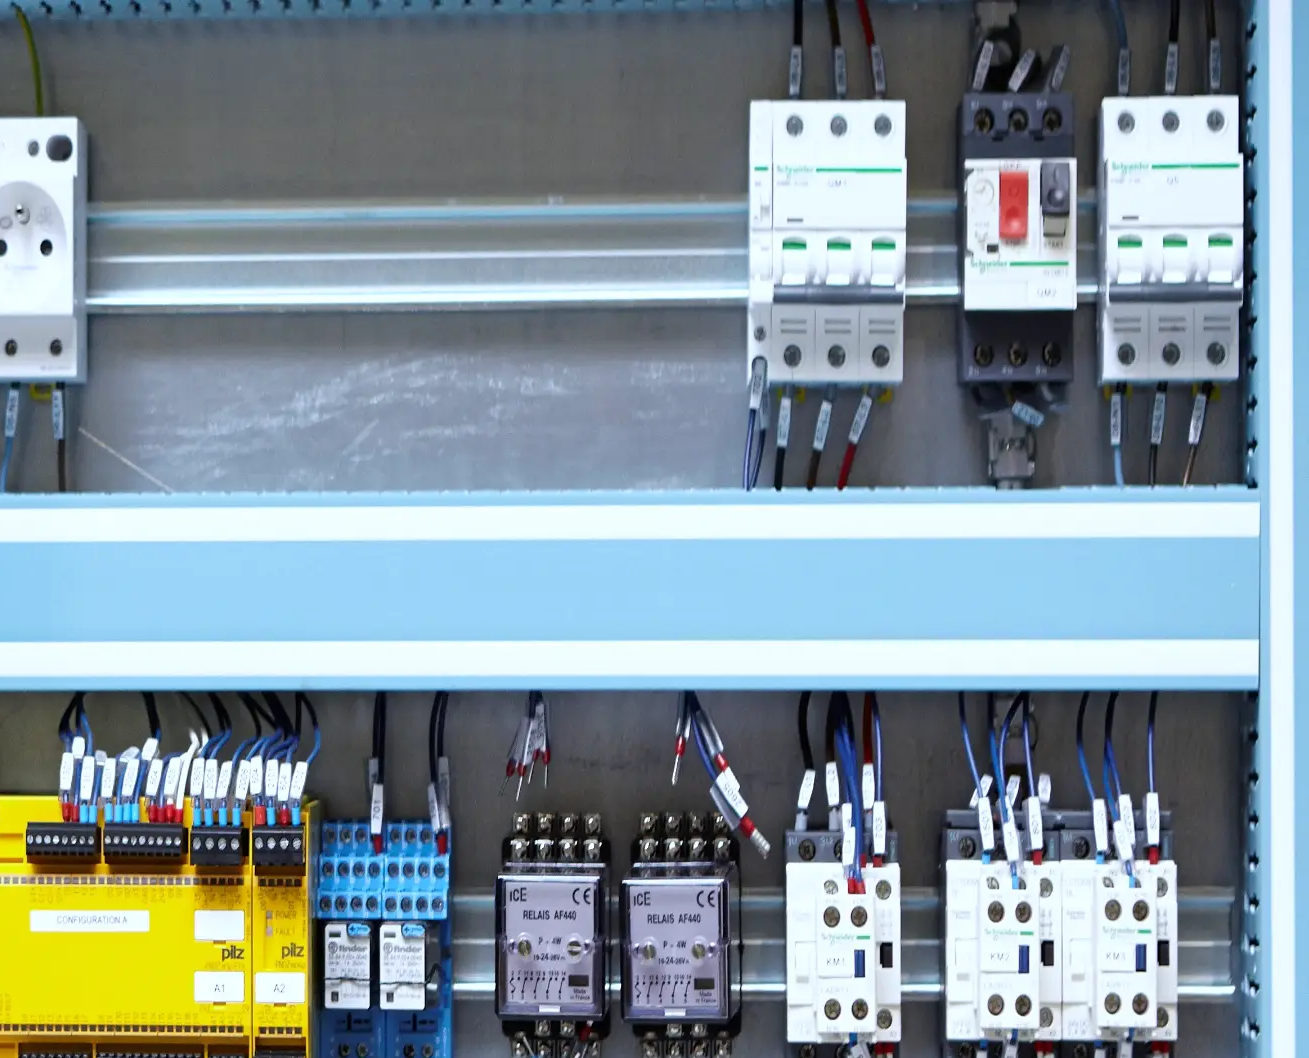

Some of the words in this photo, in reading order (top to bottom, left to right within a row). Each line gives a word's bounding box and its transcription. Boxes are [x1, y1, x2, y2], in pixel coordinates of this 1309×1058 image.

[57, 915, 120, 924] CONFIGURATION
[122, 916, 128, 924] A
[523, 910, 550, 920] RELAIS
[554, 910, 577, 920] AF440
[647, 914, 674, 924] RELAIS
[678, 914, 701, 924] AF440
[222, 945, 245, 961] pilz
[282, 942, 304, 959] pilz
[394, 945, 422, 953] finder
[990, 952, 1010, 961] KM2
[826, 957, 845, 966] KM1
[213, 984, 225, 993] A1
[273, 983, 286, 993] A2
